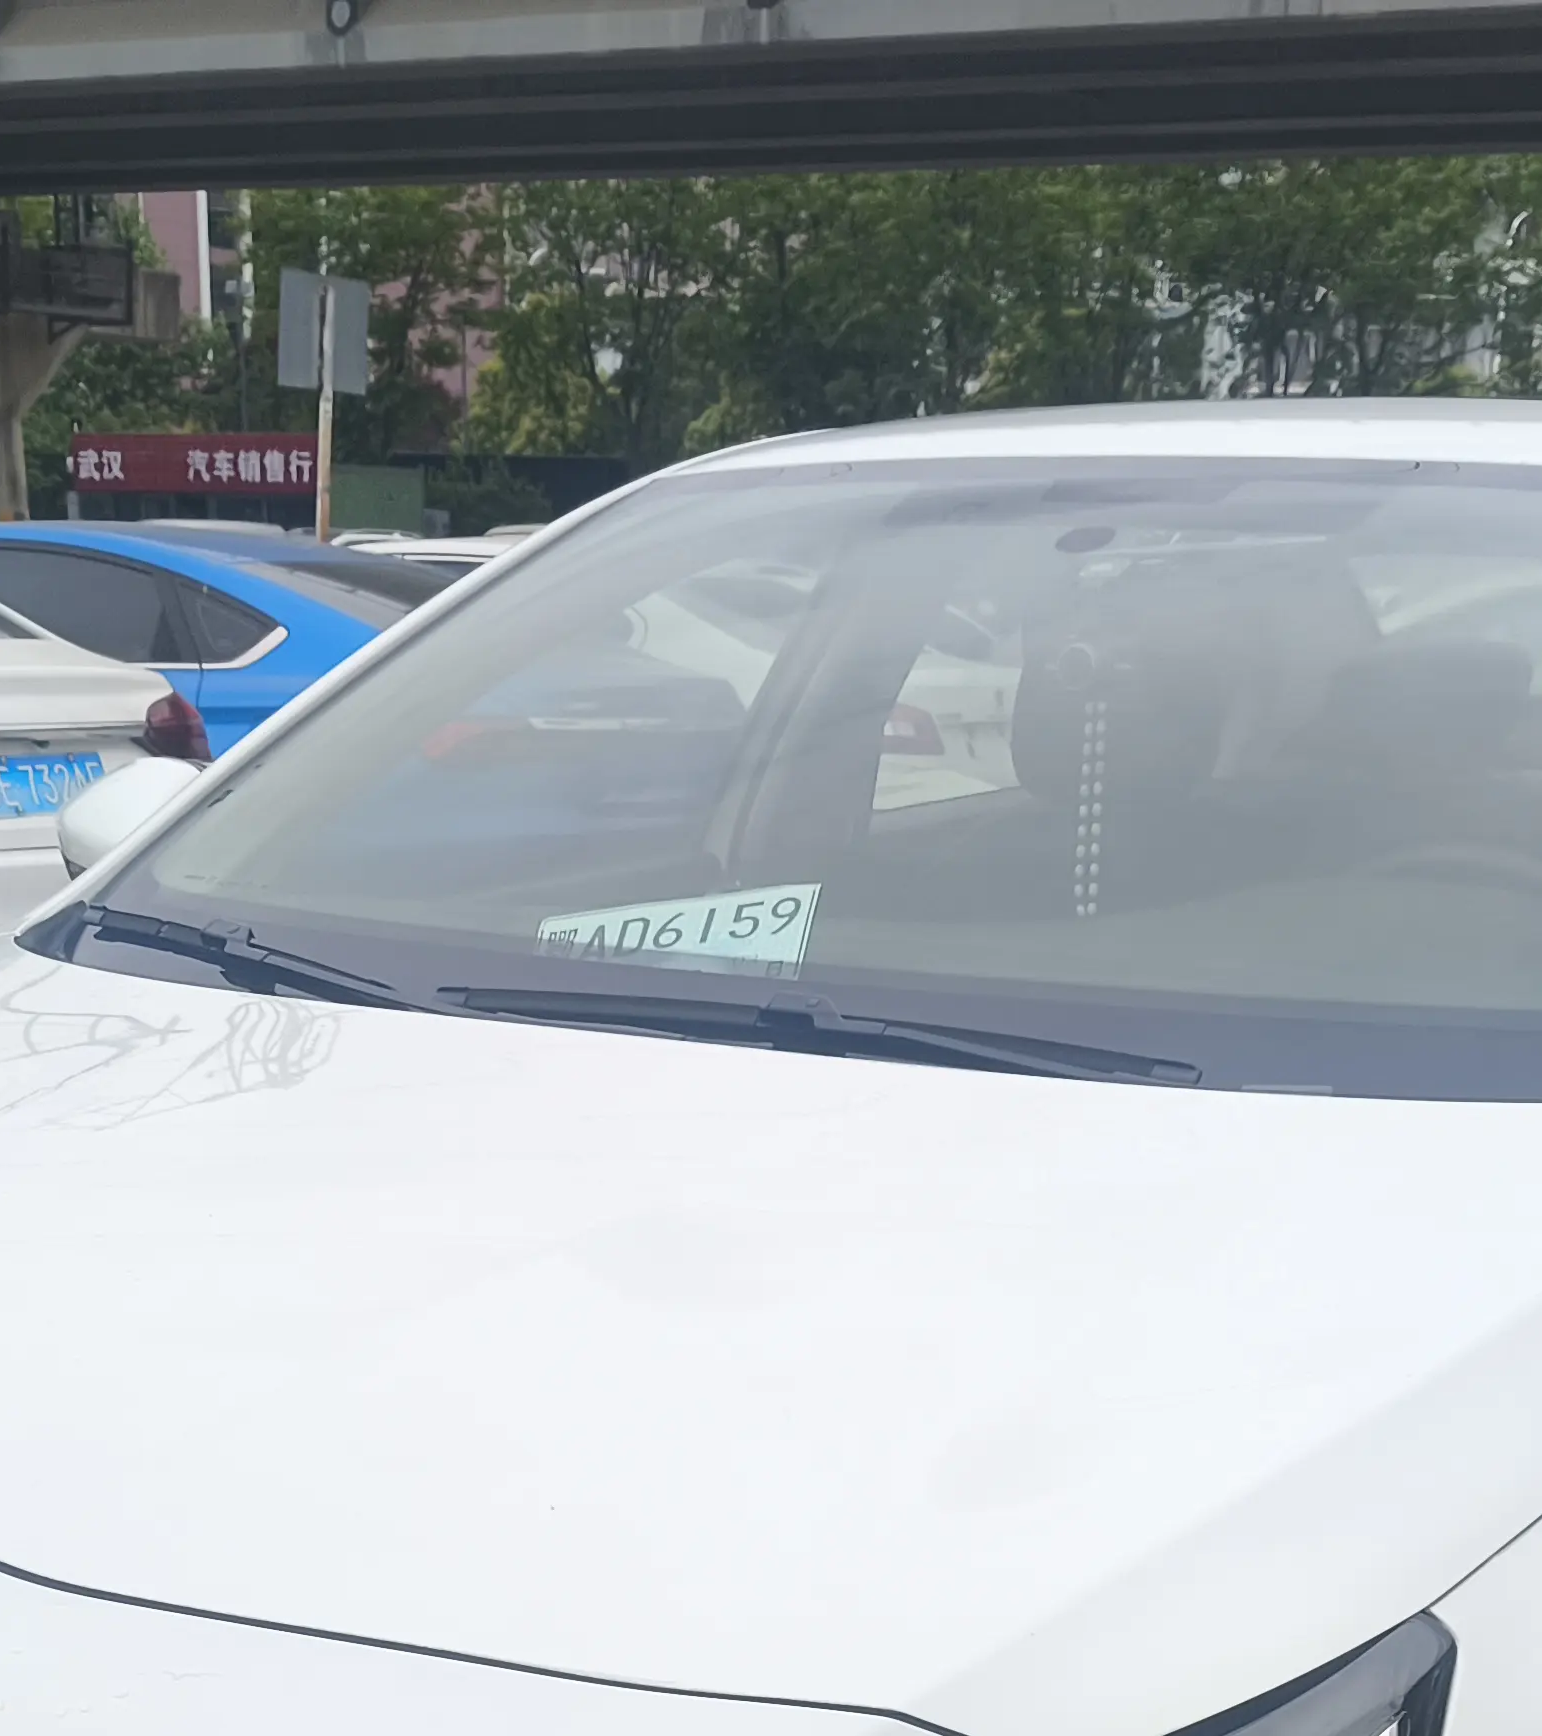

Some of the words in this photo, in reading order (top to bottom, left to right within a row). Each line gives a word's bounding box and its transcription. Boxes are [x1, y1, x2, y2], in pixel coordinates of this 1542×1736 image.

[76, 447, 125, 482] 武汉
[187, 446, 313, 484] 汽车销售行
